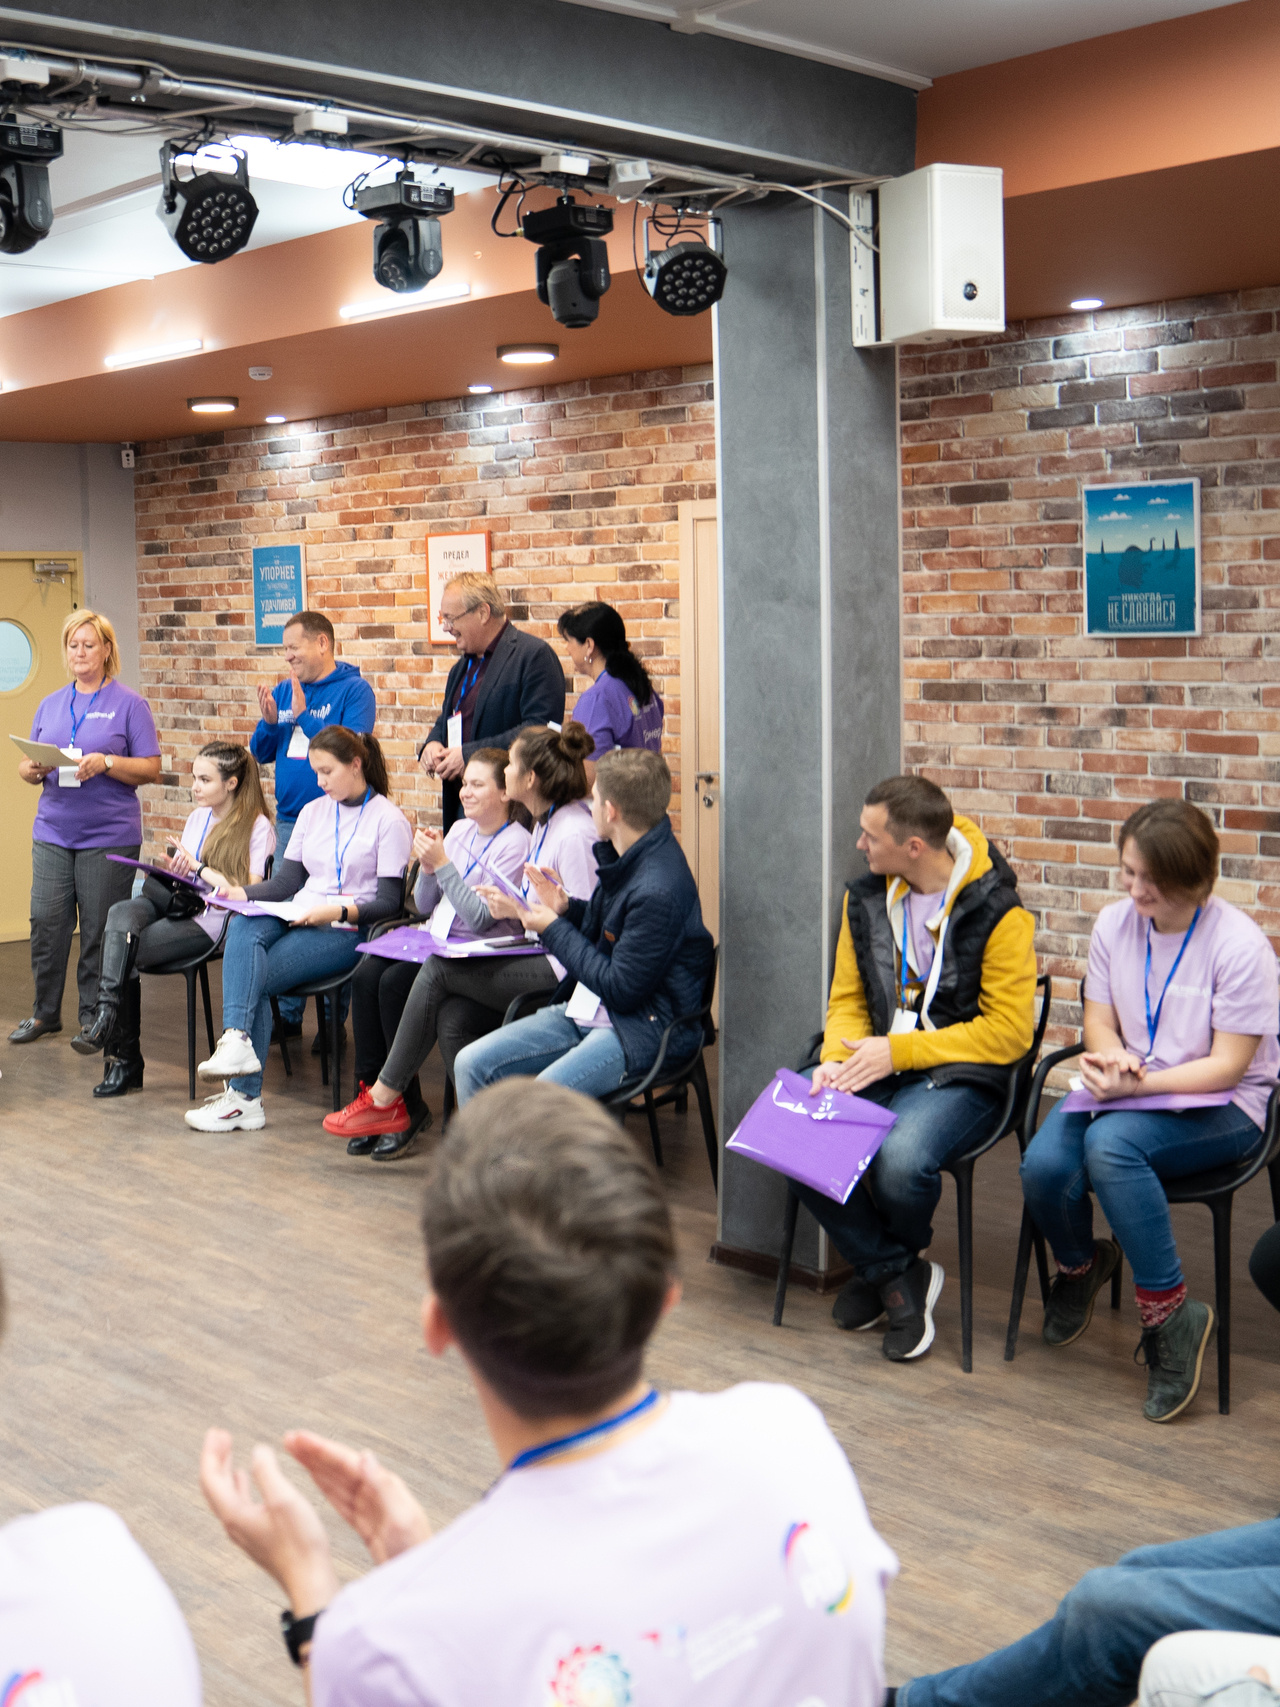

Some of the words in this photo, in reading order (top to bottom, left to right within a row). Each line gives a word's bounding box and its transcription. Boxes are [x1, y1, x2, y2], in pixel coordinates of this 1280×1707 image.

[443, 550, 470, 560] ПРЕДЕЛ
[259, 565, 296, 581] УПОРНЕЕ
[261, 596, 297, 612] УДАЧЛИВЕЙ
[1121, 592, 1162, 602] НИКОГДА
[1108, 602, 1119, 623] НЕ
